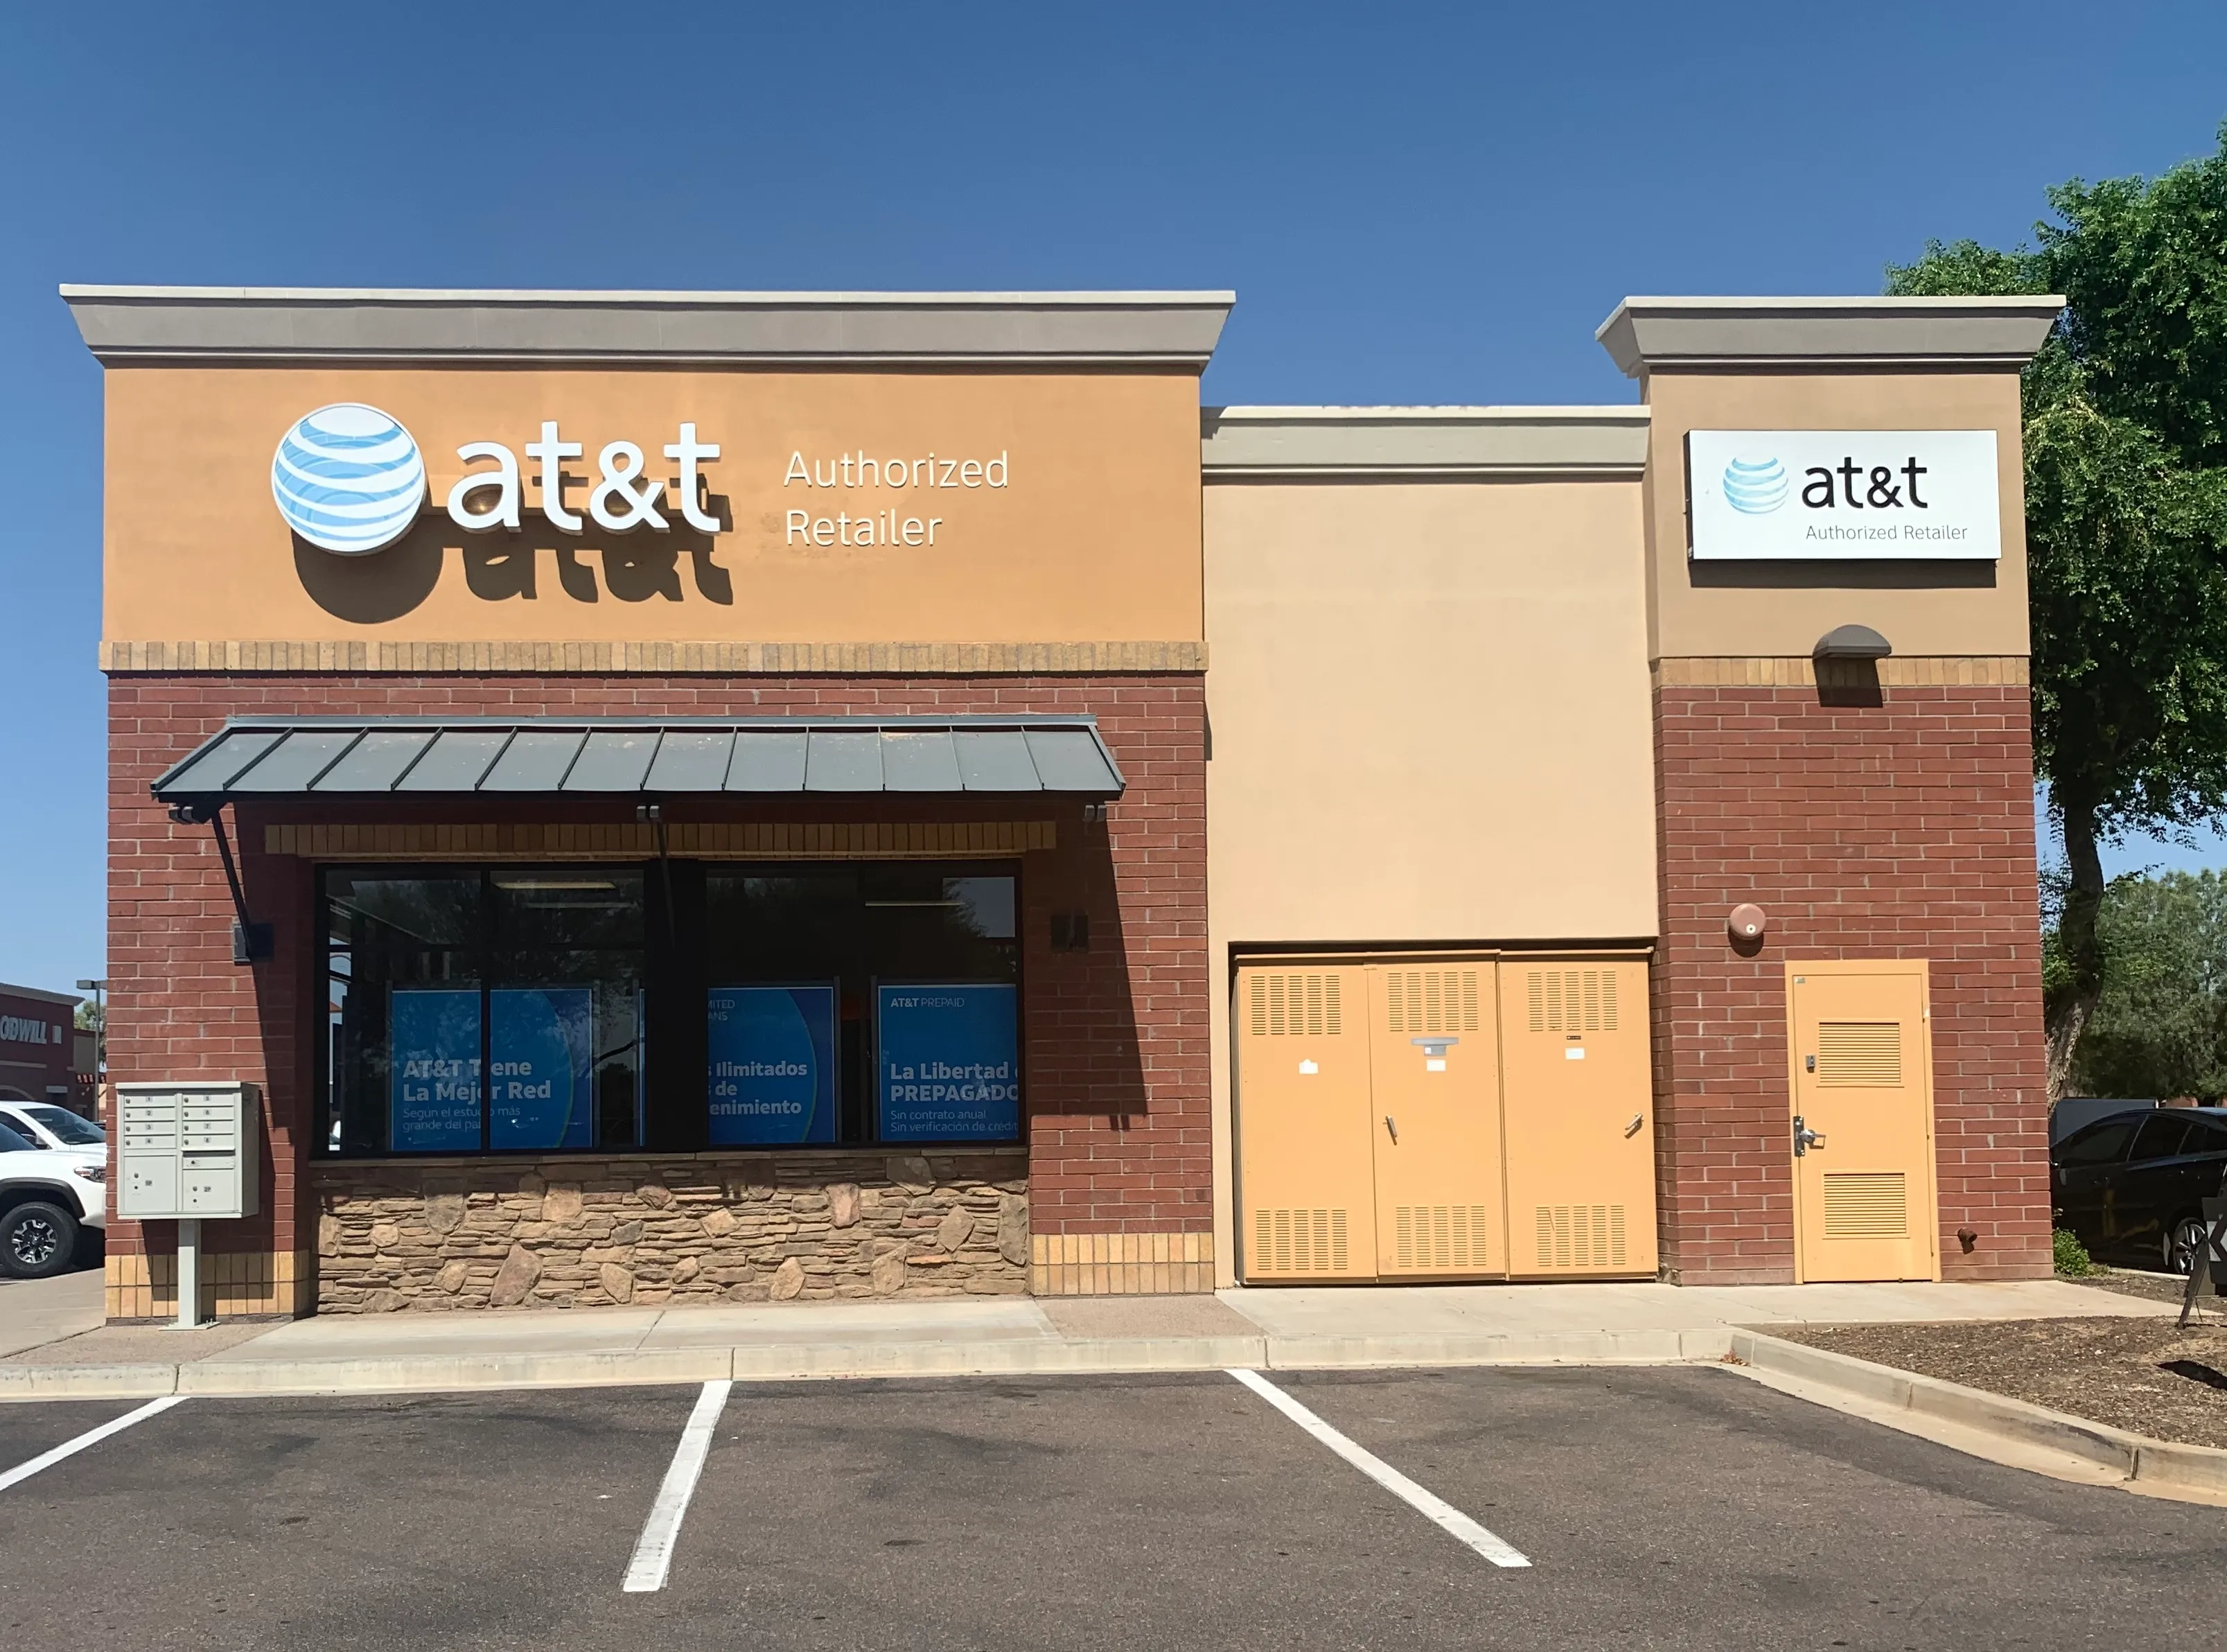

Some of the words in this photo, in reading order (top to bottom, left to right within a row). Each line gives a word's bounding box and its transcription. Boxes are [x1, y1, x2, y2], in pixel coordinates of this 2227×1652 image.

[448, 421, 720, 533] at&t
[783, 450, 1010, 489] Authorized
[1802, 457, 1928, 509] at&t
[786, 510, 942, 547] Retailer
[1806, 525, 1897, 541] Authorized
[1904, 524, 1968, 540] Retailer
[890, 998, 919, 1008] AT&T
[921, 997, 965, 1008] PREPAID
[403, 1059, 464, 1078] AT&T
[468, 1058, 532, 1076] Tene
[716, 1060, 808, 1077] Ilimitados
[890, 1062, 914, 1080] La
[920, 1062, 1009, 1080] Libertad
[403, 1083, 430, 1102] La
[508, 1080, 552, 1100] Red
[715, 1081, 738, 1096] de
[403, 1107, 439, 1121] Según
[441, 1107, 450, 1117] el
[498, 1106, 520, 1116] más
[890, 1110, 906, 1120] Sin
[910, 1110, 955, 1120] contrato
[958, 1109, 986, 1119] anual
[403, 1121, 441, 1132] grande
[444, 1120, 461, 1130] del
[890, 1122, 906, 1132] Sin
[910, 1122, 969, 1132] verificación
[972, 1122, 985, 1132] de
